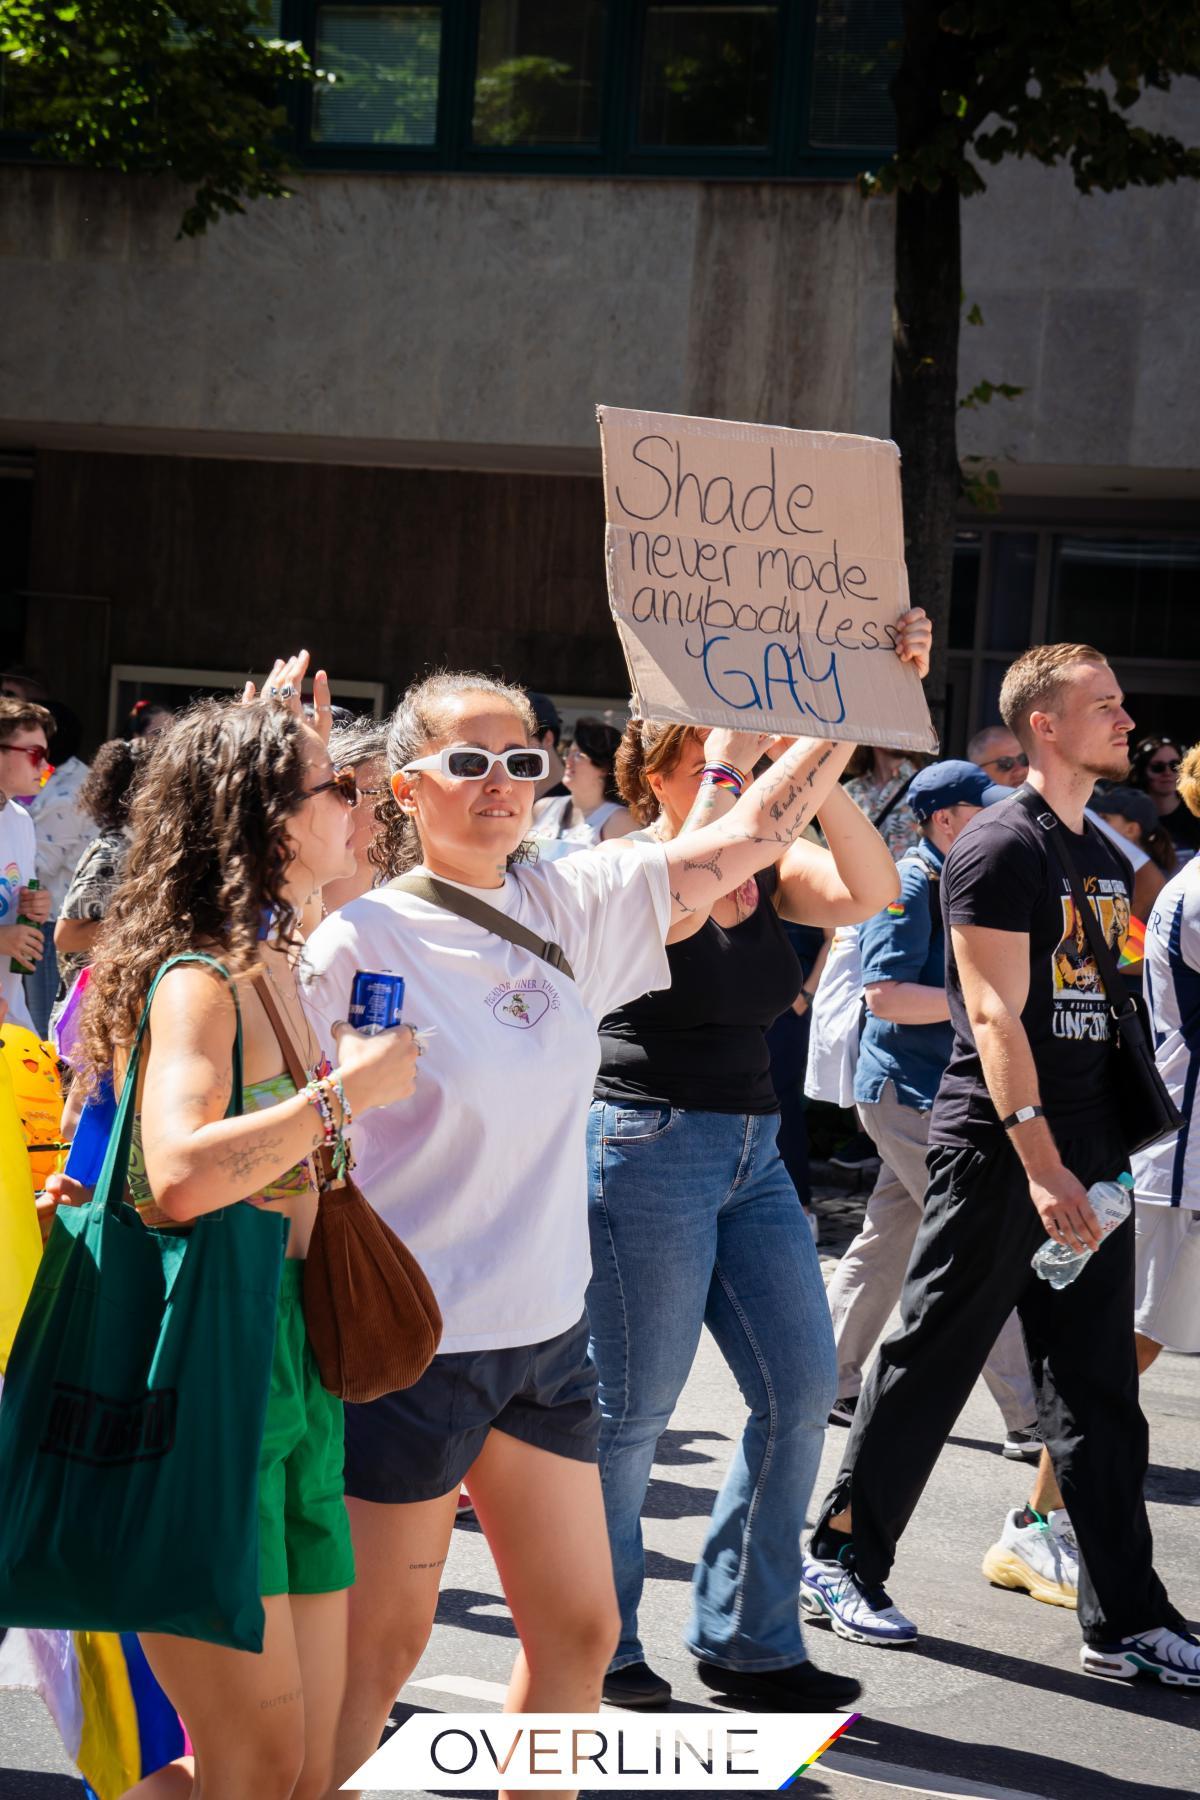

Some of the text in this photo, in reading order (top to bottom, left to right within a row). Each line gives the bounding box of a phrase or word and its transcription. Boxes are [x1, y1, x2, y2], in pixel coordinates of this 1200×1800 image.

[615, 434, 823, 535] Shade
[628, 530, 878, 601] never made
[632, 585, 801, 659] anybody
[702, 635, 846, 725] GAY
[1083, 876, 1098, 894] VS
